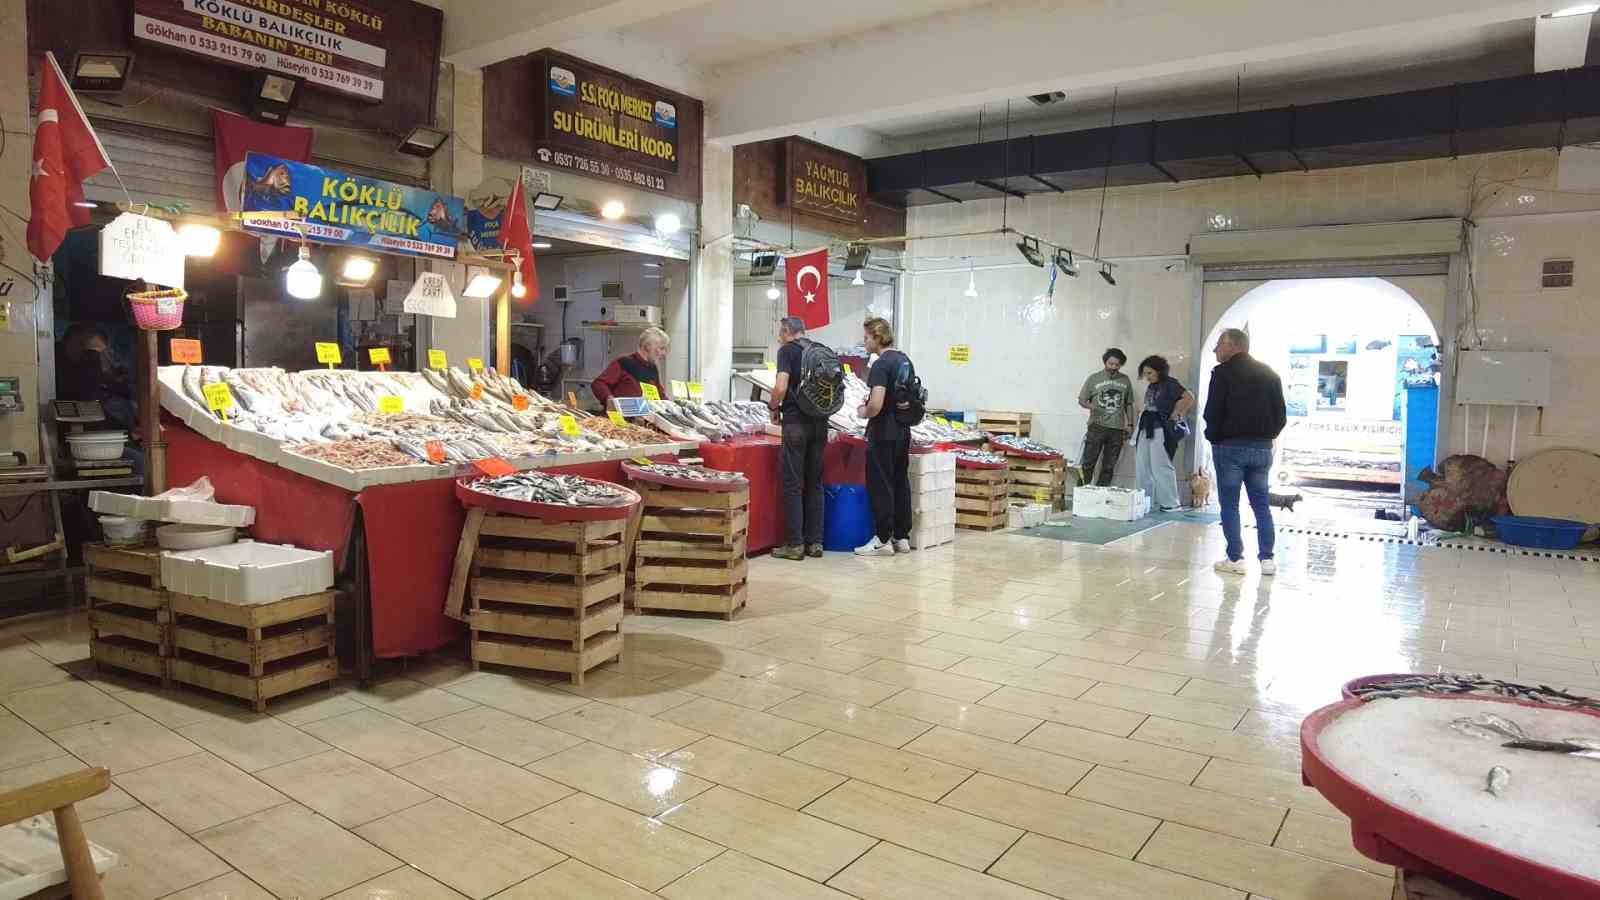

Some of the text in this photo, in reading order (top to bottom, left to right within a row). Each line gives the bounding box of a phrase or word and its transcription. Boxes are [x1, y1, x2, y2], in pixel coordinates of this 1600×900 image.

[201, 16, 288, 50] BABANIN
[259, 17, 343, 50] BALIKÇILIK
[145, 23, 187, 43] Gökhan
[189, 35, 196, 46] 0
[199, 38, 217, 51] 533
[220, 42, 238, 57] 215
[241, 48, 253, 60] 79
[255, 52, 266, 64] 00
[277, 56, 310, 74] Hüseyin
[311, 66, 318, 76] 0
[319, 68, 334, 80] 533
[352, 77, 362, 88] 39
[363, 81, 373, 91] 39
[597, 86, 620, 115] FOÇA
[620, 94, 653, 121] MERKEZ
[553, 110, 676, 162] SU ÜRÜNLERİ KOOP.
[322, 177, 403, 211] KÖKLÜ
[293, 195, 424, 237] BALIKÇILIK
